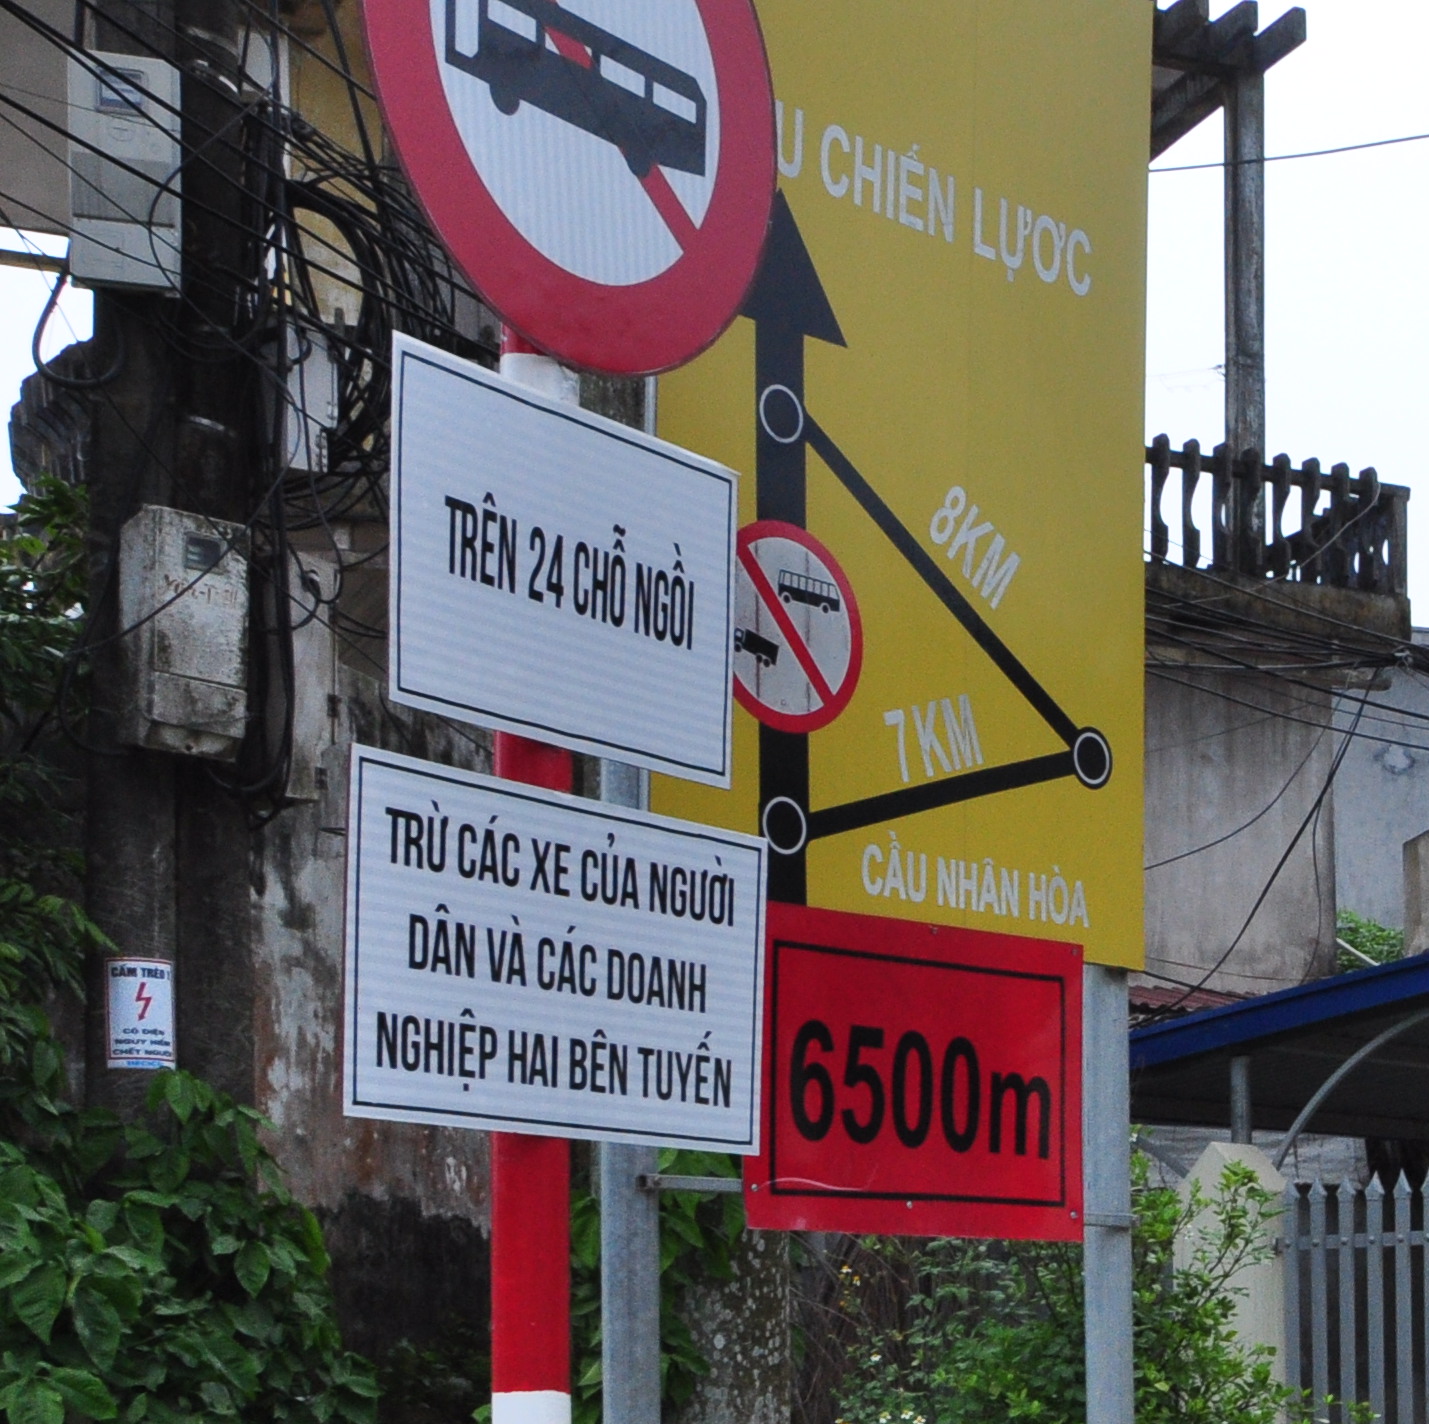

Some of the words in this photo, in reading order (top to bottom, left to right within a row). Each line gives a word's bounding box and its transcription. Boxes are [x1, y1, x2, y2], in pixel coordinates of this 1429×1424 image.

[820, 124, 955, 243] CHIẾN
[974, 187, 1093, 296] LƯỢC
[444, 491, 517, 594] TRÊN
[528, 526, 564, 608] 24
[573, 524, 626, 628] CHỖ
[634, 542, 694, 650] NGỒI
[929, 485, 1021, 609] 8KM
[385, 800, 449, 872] TRỪ
[457, 815, 520, 887] CÁC
[530, 838, 571, 896] XE
[580, 832, 639, 909] CỦA
[649, 855, 734, 927] NGƯỜI
[861, 830, 927, 903] CẦU
[937, 857, 1019, 917] NHÂN
[1028, 865, 1090, 928] HÒA
[408, 903, 475, 979] DÂN
[487, 915, 527, 986] VÀ
[537, 925, 597, 997] CÁC
[607, 948, 707, 1013] DOANH
[376, 1008, 498, 1092] NGHIỆP
[508, 1029, 558, 1088] HAI
[569, 1029, 627, 1096] BÊN
[637, 1031, 732, 1108] TUYẾN
[790, 1019, 1051, 1160] 6500m
